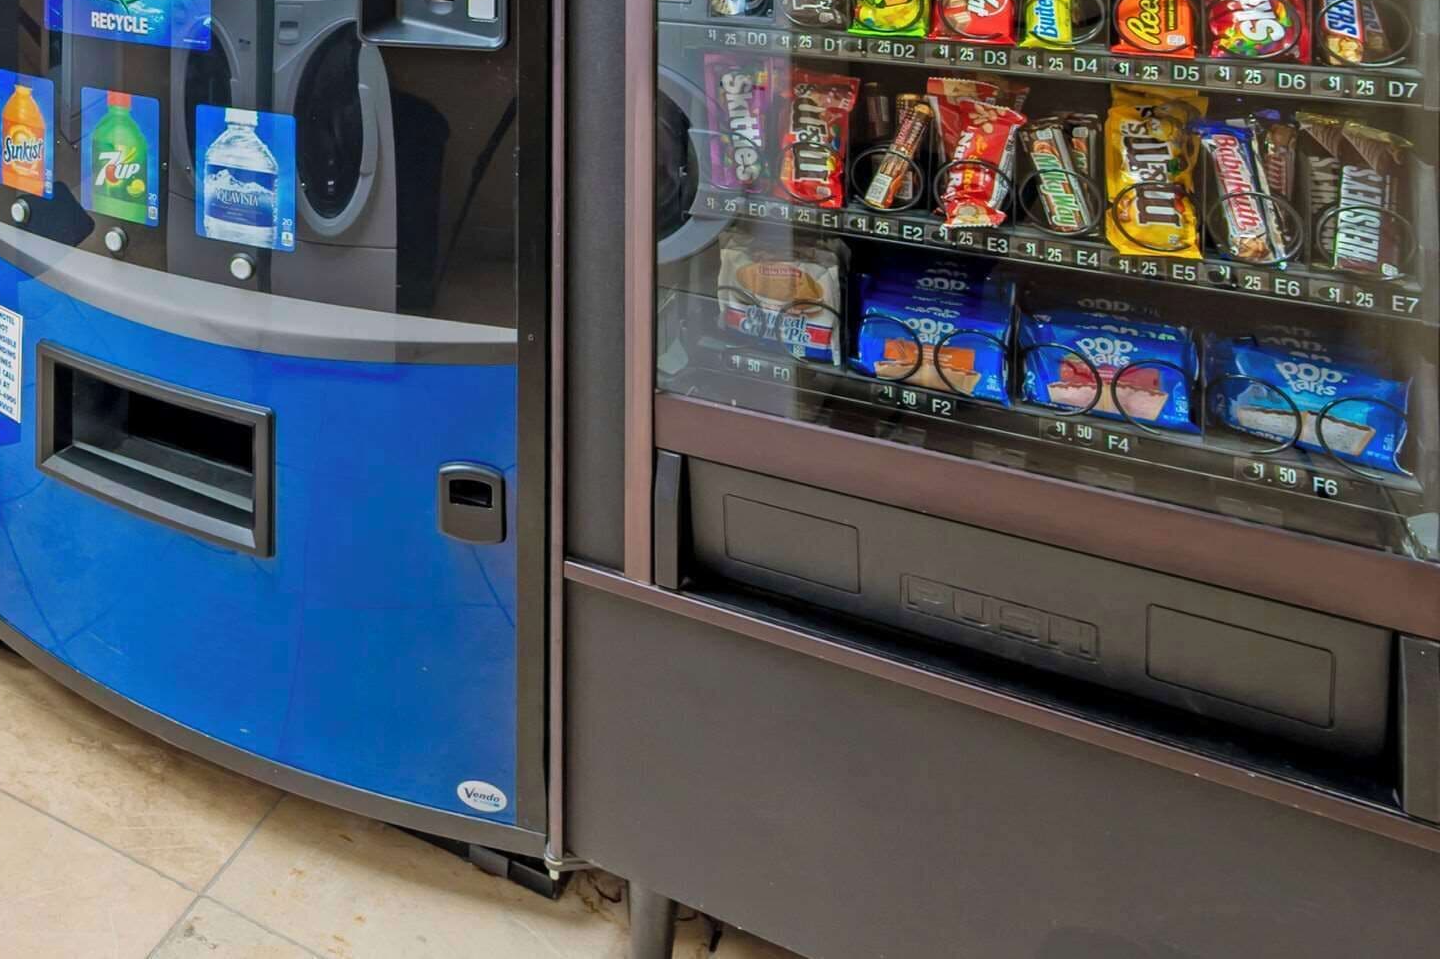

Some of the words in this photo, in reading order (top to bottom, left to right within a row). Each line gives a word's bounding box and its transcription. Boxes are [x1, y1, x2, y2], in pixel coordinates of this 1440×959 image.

[91, 11, 149, 34] RECYCLE
[748, 32, 767, 45] D0
[825, 38, 842, 51] D1
[894, 43, 915, 58] D2
[985, 51, 1007, 65] D3
[1074, 58, 1098, 73] D4
[1174, 65, 1200, 81] D5
[1278, 73, 1307, 89] D6
[1388, 81, 1419, 98] D7
[3, 137, 43, 162] Sunkist
[749, 203, 767, 213] E0
[1336, 164, 1383, 263] HERSHEY'S
[822, 213, 838, 224] E1
[903, 225, 923, 241] E2
[987, 237, 1008, 253] E3
[1076, 250, 1099, 266] E4
[1172, 264, 1196, 281] E5
[1275, 278, 1301, 297] E6
[1392, 295, 1419, 313] E7
[773, 366, 790, 381] F0
[932, 399, 952, 416] F2
[1108, 435, 1129, 452] F4
[1313, 476, 1338, 496] F6
[907, 576, 1094, 660] PUSH
[464, 787, 500, 802] Vendo
